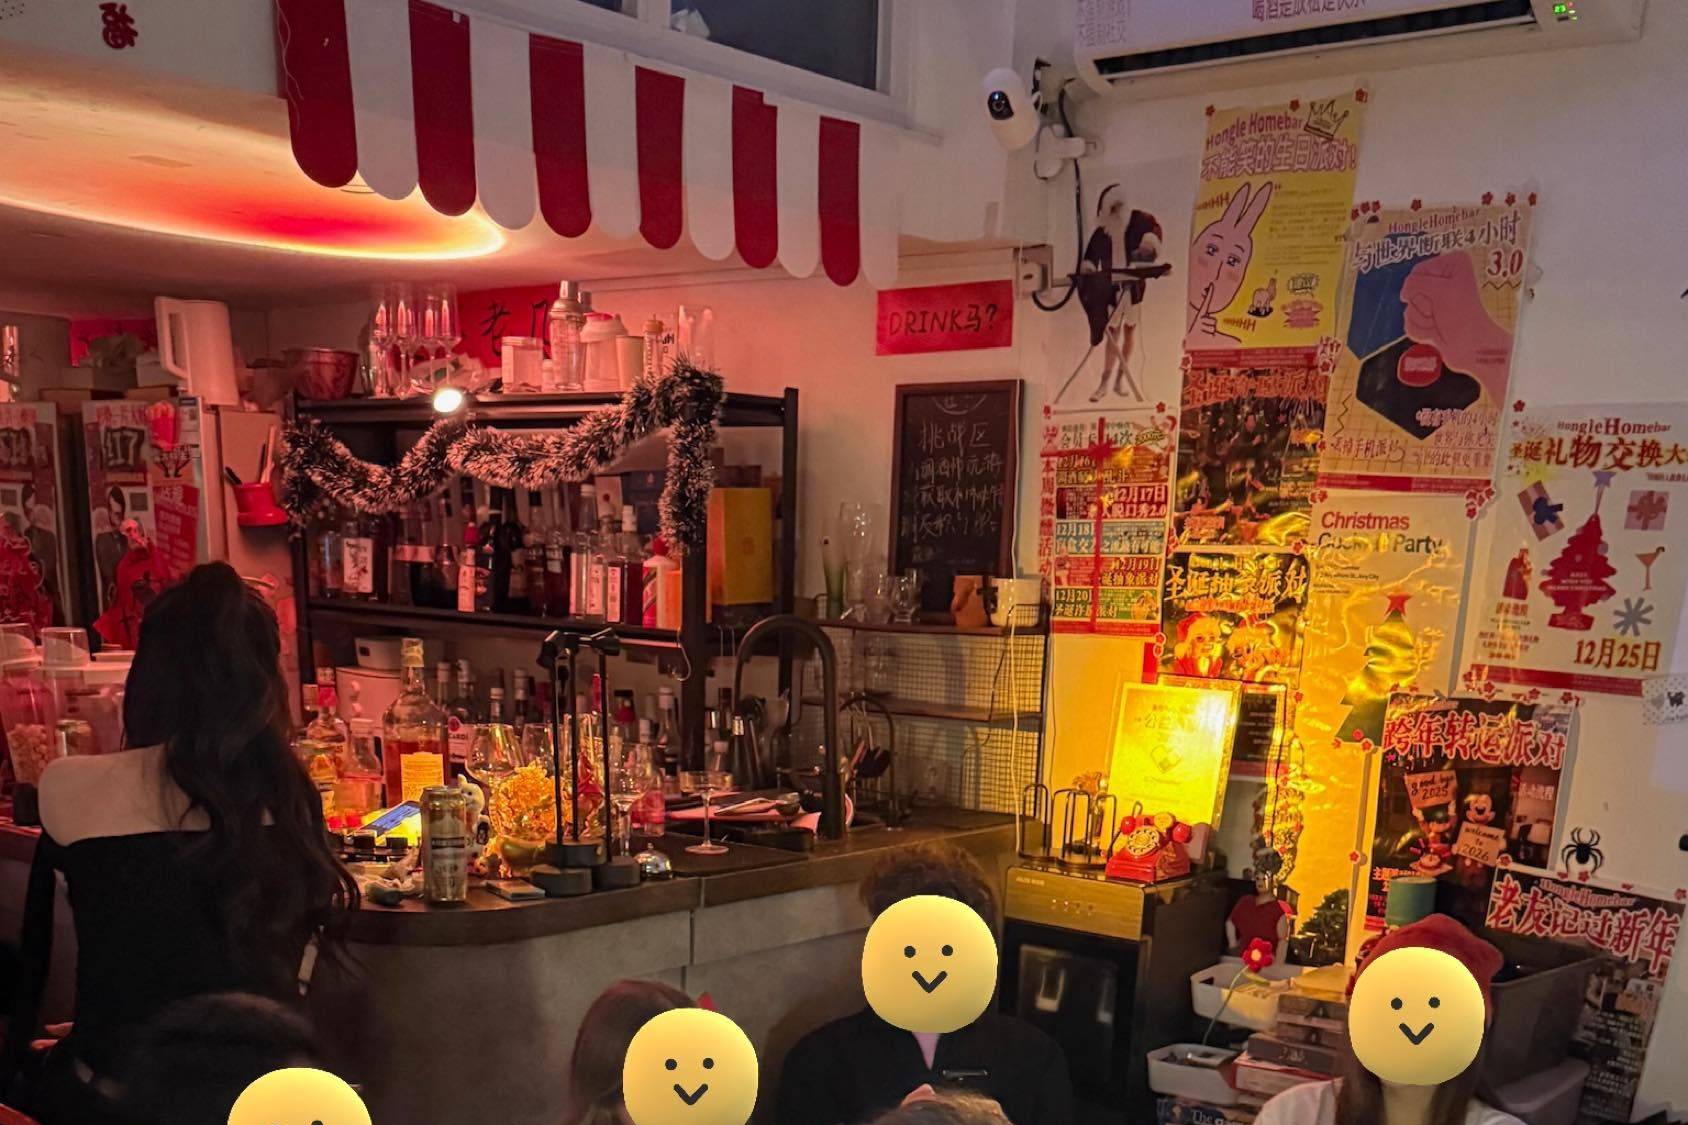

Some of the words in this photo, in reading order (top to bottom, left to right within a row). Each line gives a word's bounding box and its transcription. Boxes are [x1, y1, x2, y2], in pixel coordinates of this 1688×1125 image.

[1206, 117, 1246, 150] Hongle
[1250, 111, 1303, 134] Homebar
[1487, 250, 1523, 278] 3.0
[1510, 435, 1688, 472] 圣诞礼物交换大
[1321, 511, 1410, 531] Christmas
[1574, 637, 1662, 672] 12月25日
[1383, 710, 1567, 769] 跨年转运派对
[1462, 843, 1490, 862] 2026
[1486, 873, 1681, 975] 老友记过新年
